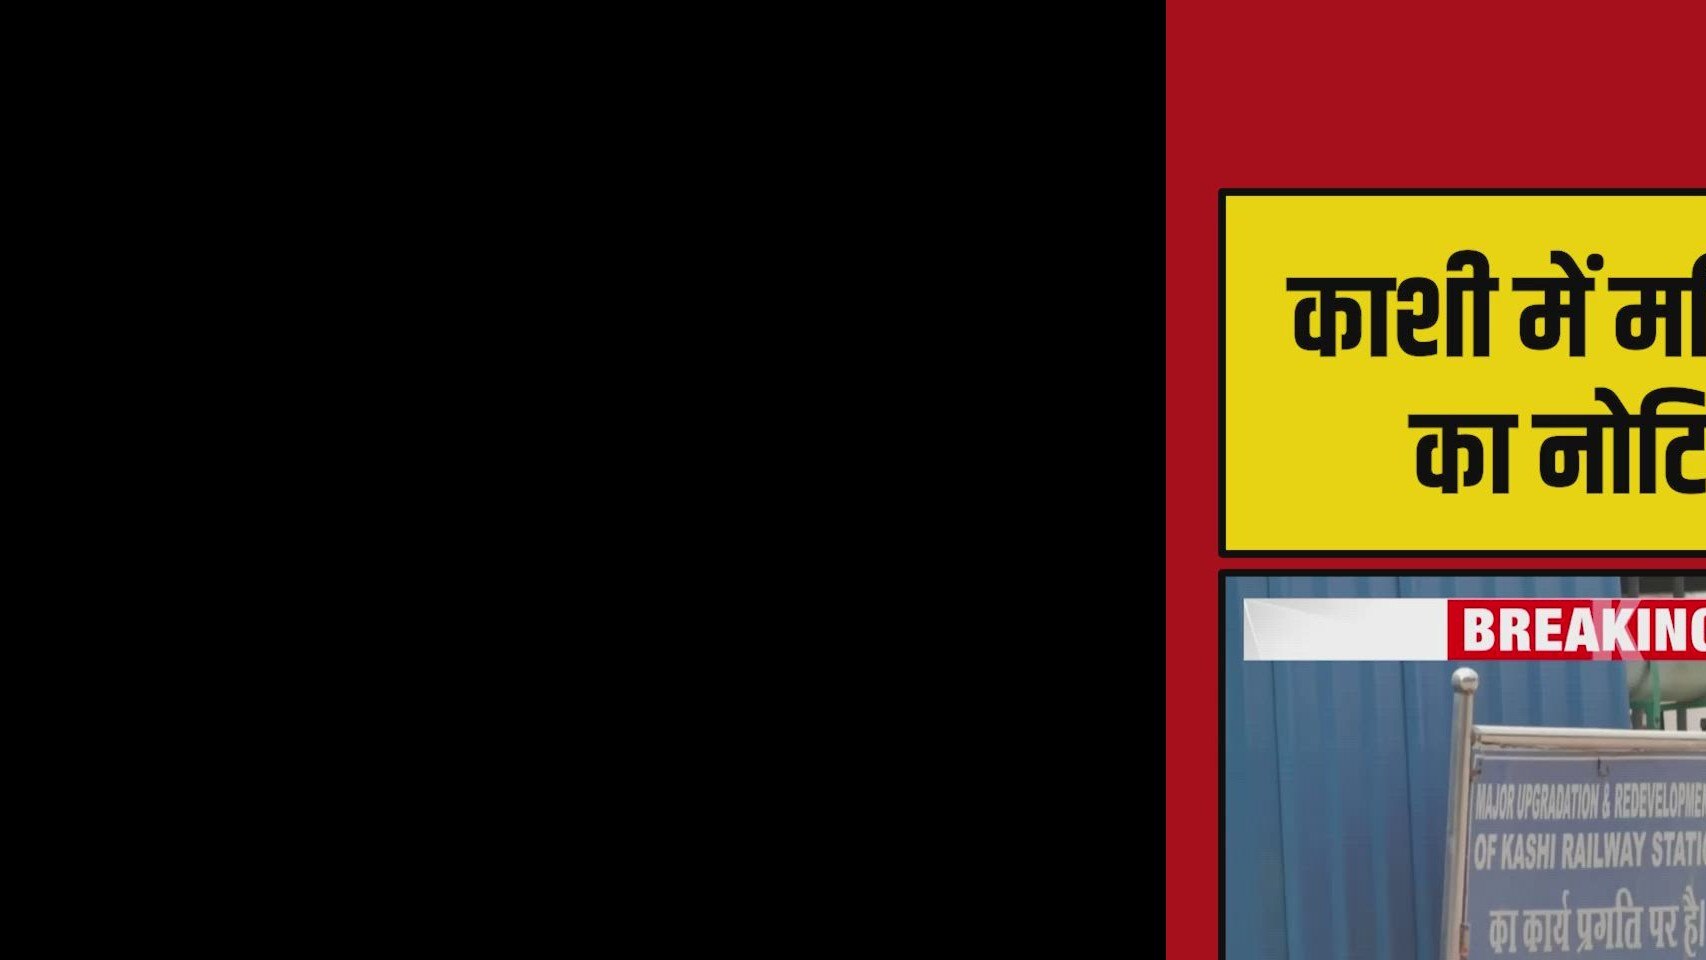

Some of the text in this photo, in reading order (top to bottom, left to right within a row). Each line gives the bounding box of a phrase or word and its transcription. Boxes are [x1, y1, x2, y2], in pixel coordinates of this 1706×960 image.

[1475, 783, 1515, 820] MAJOR
[1515, 783, 1600, 820] UPGRADATION
[1601, 783, 1611, 819] &
[1474, 833, 1498, 870] OF
[1501, 832, 1555, 870] KASHI
[1561, 831, 1647, 868] RAILWAY
[1489, 909, 1519, 953] का
[1522, 889, 1572, 953] कार्य
[1576, 887, 1644, 953] प्रगति
[1648, 905, 1680, 948] पर
